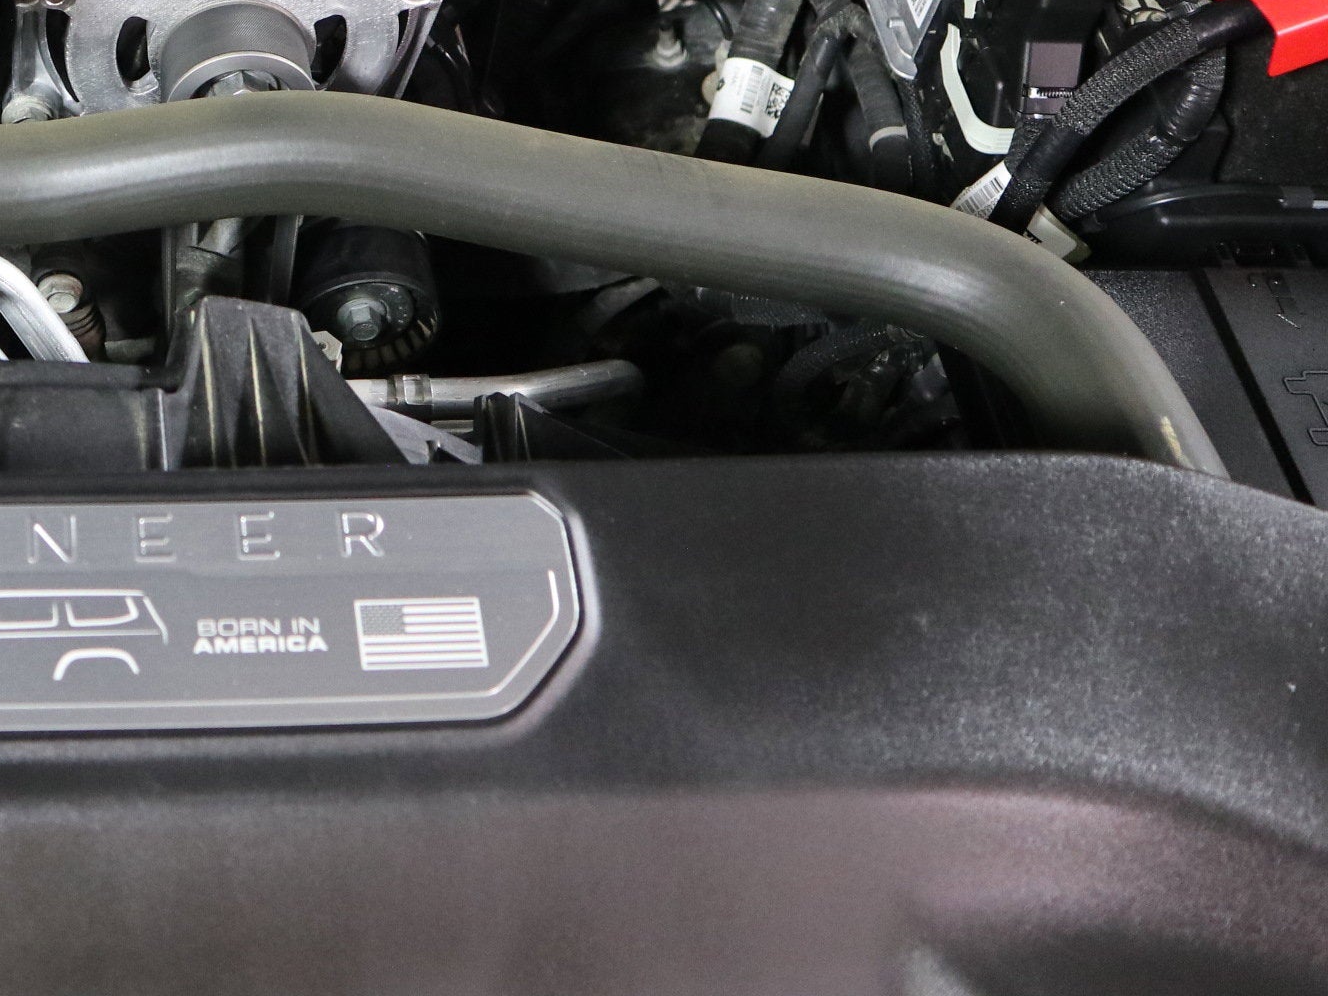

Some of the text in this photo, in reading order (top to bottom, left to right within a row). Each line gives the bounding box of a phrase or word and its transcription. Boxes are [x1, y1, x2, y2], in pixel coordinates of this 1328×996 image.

[197, 616, 320, 637] BORN IN
[193, 634, 329, 654] AMERICA
